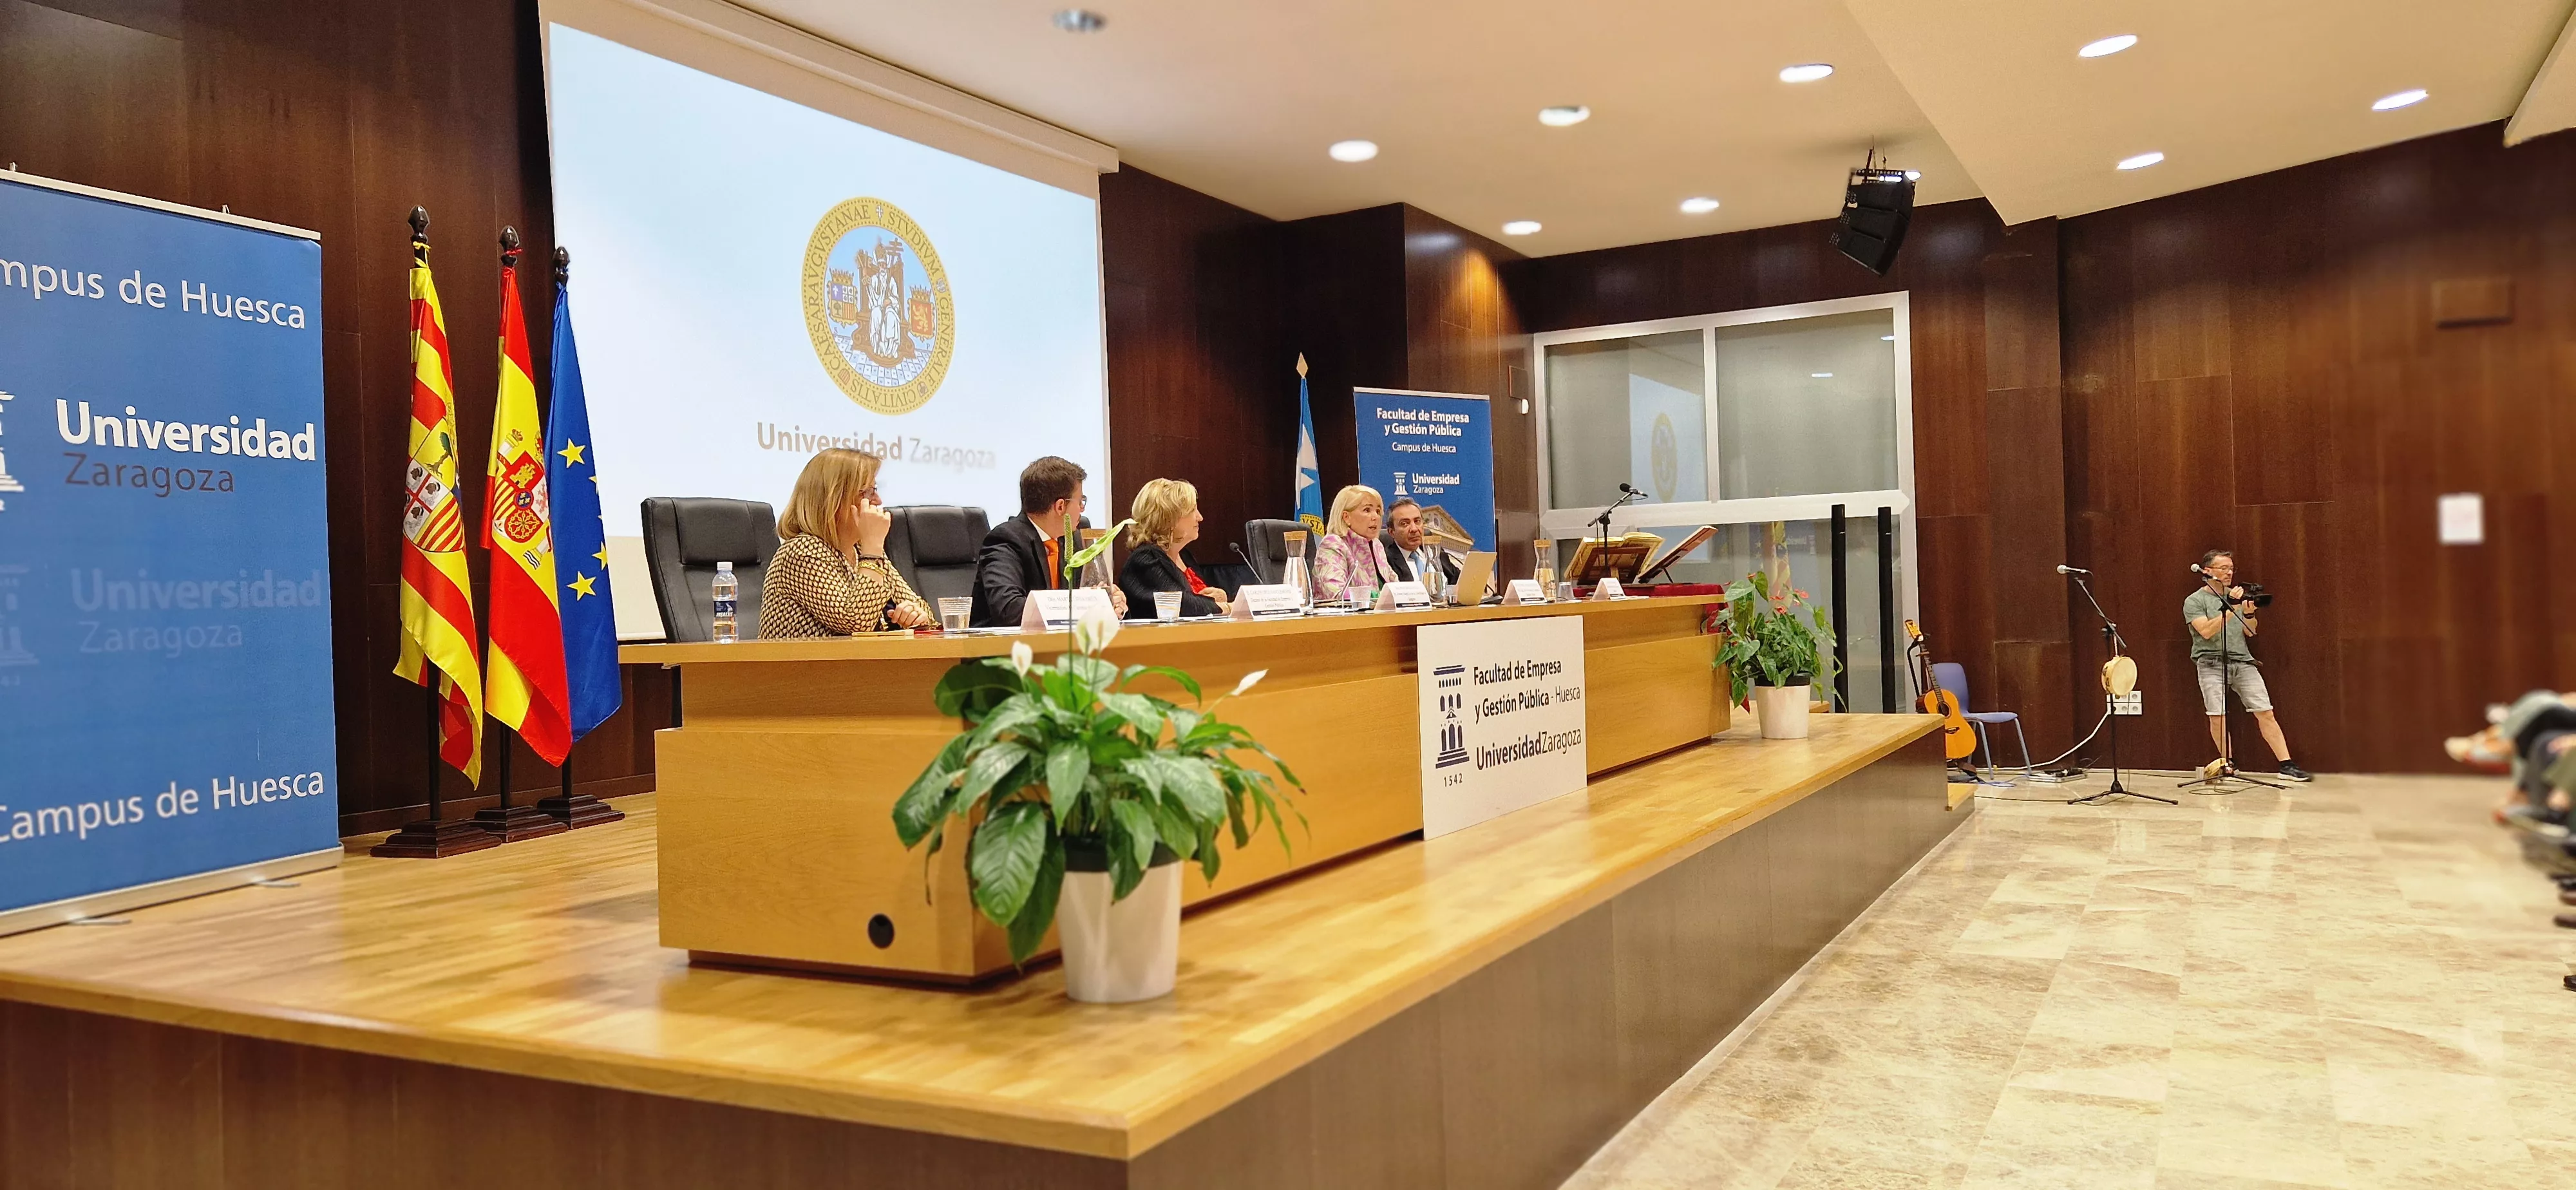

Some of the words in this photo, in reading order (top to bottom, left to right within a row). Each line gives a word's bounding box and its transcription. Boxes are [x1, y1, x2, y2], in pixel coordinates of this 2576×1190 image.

[888, 211, 940, 275] STVDIVM
[0, 260, 105, 299] mpus
[119, 270, 167, 308] de
[181, 279, 305, 329] Huesca
[808, 205, 870, 370] CAESARAVGVSTANAE
[925, 297, 951, 388] GENERALE
[850, 379, 916, 408] CIVITATIS
[56, 398, 316, 461] Universidad
[1376, 408, 1416, 420] Facultad
[1418, 410, 1430, 421] de
[1432, 410, 1470, 424] Empresa
[1385, 426, 1390, 436] y
[1392, 423, 1427, 435] Gestión
[1429, 424, 1462, 437] Pública
[757, 422, 902, 461] Universidad
[909, 437, 997, 473] Zaragoza
[1392, 442, 1421, 453] Campus
[1422, 443, 1431, 452] de
[1432, 444, 1457, 453] Huesca
[64, 453, 234, 497] Zaragoza
[1412, 473, 1460, 485] Universidad
[1414, 485, 1444, 495] Zaragoza
[70, 567, 322, 612] Universidad
[78, 620, 243, 658] Zaragoza
[1473, 661, 1512, 685] Facultad
[1514, 661, 1525, 680] de
[1527, 659, 1562, 681] Empresa
[1475, 704, 1481, 724] y
[1482, 693, 1517, 717] Gestión
[1519, 689, 1549, 710] Pública
[1555, 685, 1580, 704] Huesca
[156, 782, 199, 818] de
[213, 771, 324, 809] Huesca
[1443, 773, 1463, 787] 1542
